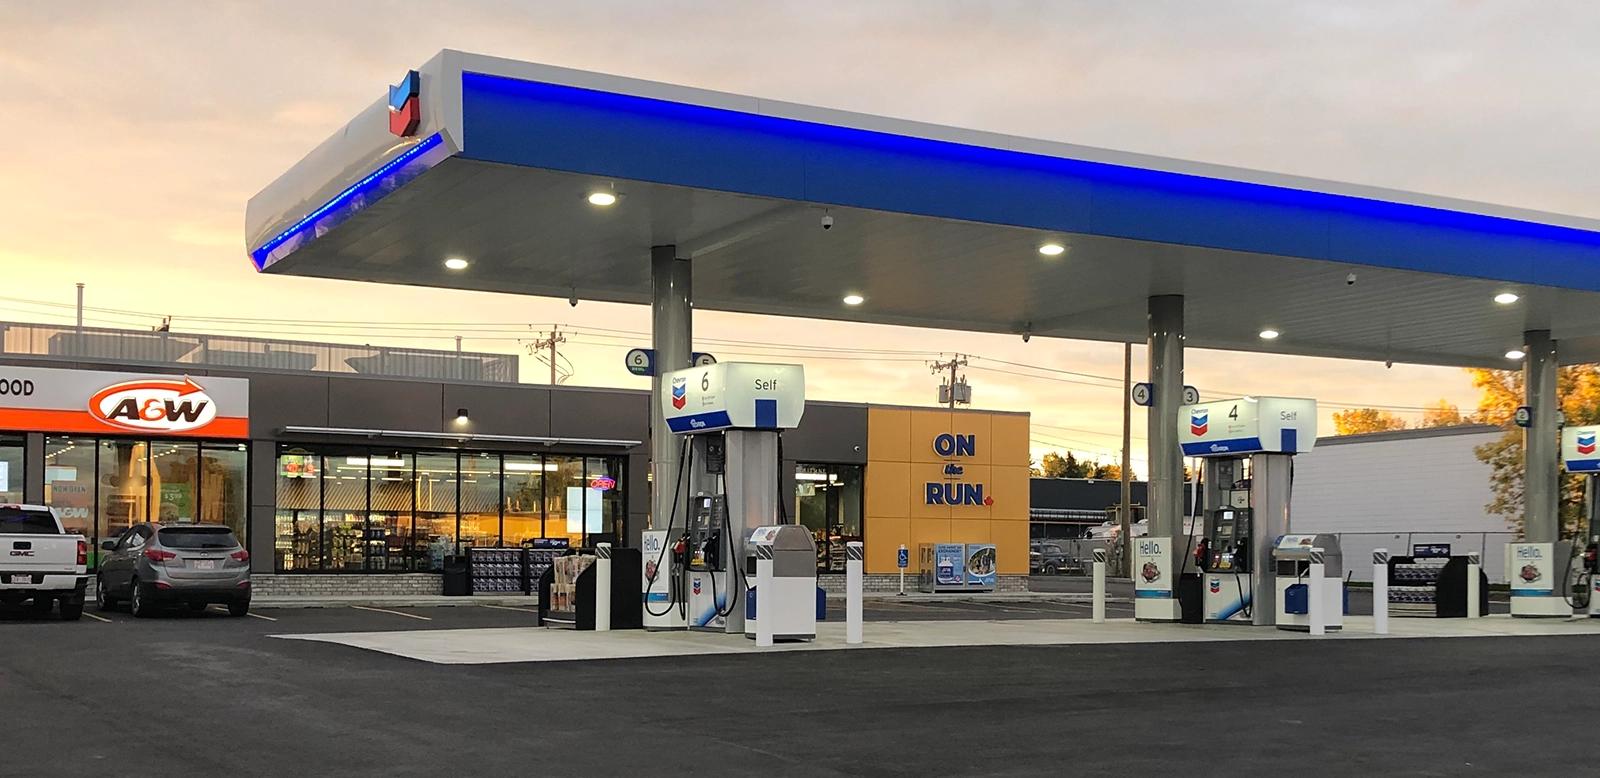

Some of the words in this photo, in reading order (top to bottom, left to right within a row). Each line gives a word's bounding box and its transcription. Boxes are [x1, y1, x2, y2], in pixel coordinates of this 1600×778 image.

[634, 354, 643, 365] 6
[0, 379, 35, 396] OOD
[701, 371, 709, 392] 6
[755, 379, 778, 391] Self
[1138, 388, 1146, 400] 4
[1186, 392, 1194, 403] 3
[104, 397, 209, 422] A&W
[1228, 404, 1239, 421] 4
[1280, 411, 1297, 421] Self
[1519, 411, 1526, 419] 2
[934, 433, 975, 457] ON
[943, 463, 964, 476] the
[590, 479, 616, 490] OPEN
[924, 482, 984, 506] RUN
[1140, 540, 1162, 555] Hello.
